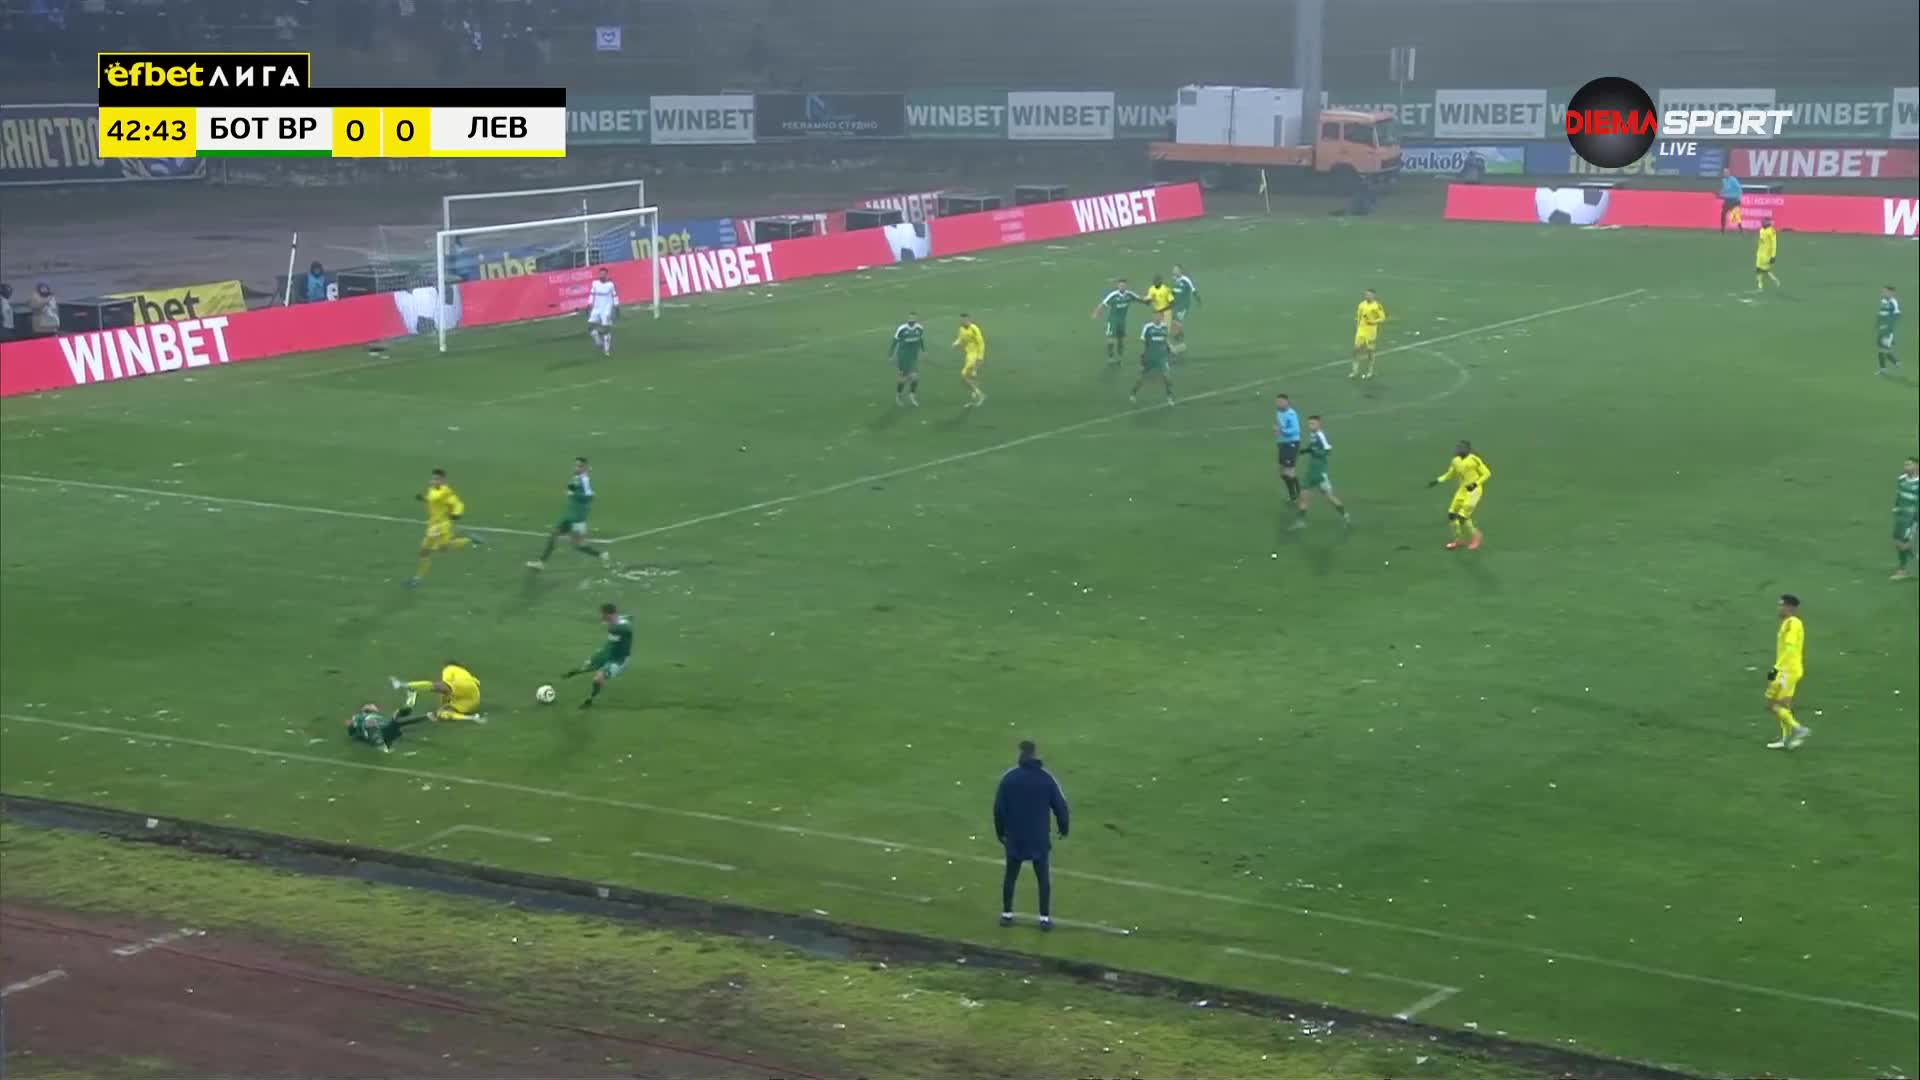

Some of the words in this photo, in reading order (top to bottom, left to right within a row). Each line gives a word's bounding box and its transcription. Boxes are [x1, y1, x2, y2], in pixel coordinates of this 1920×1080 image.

[567, 109, 648, 132] INBET
[655, 108, 754, 131] WINBET
[906, 104, 1004, 127] WINBET
[1012, 105, 1110, 126] WINBET
[1440, 103, 1542, 125] WINBET
[0, 117, 104, 168] ЯНСТВО
[1749, 150, 1888, 177] WINBET
[1071, 189, 1156, 233] WINBET
[478, 251, 536, 280] inbe
[659, 243, 774, 296] WINBET
[137, 289, 199, 324] bet
[59, 316, 230, 384] WINBET
